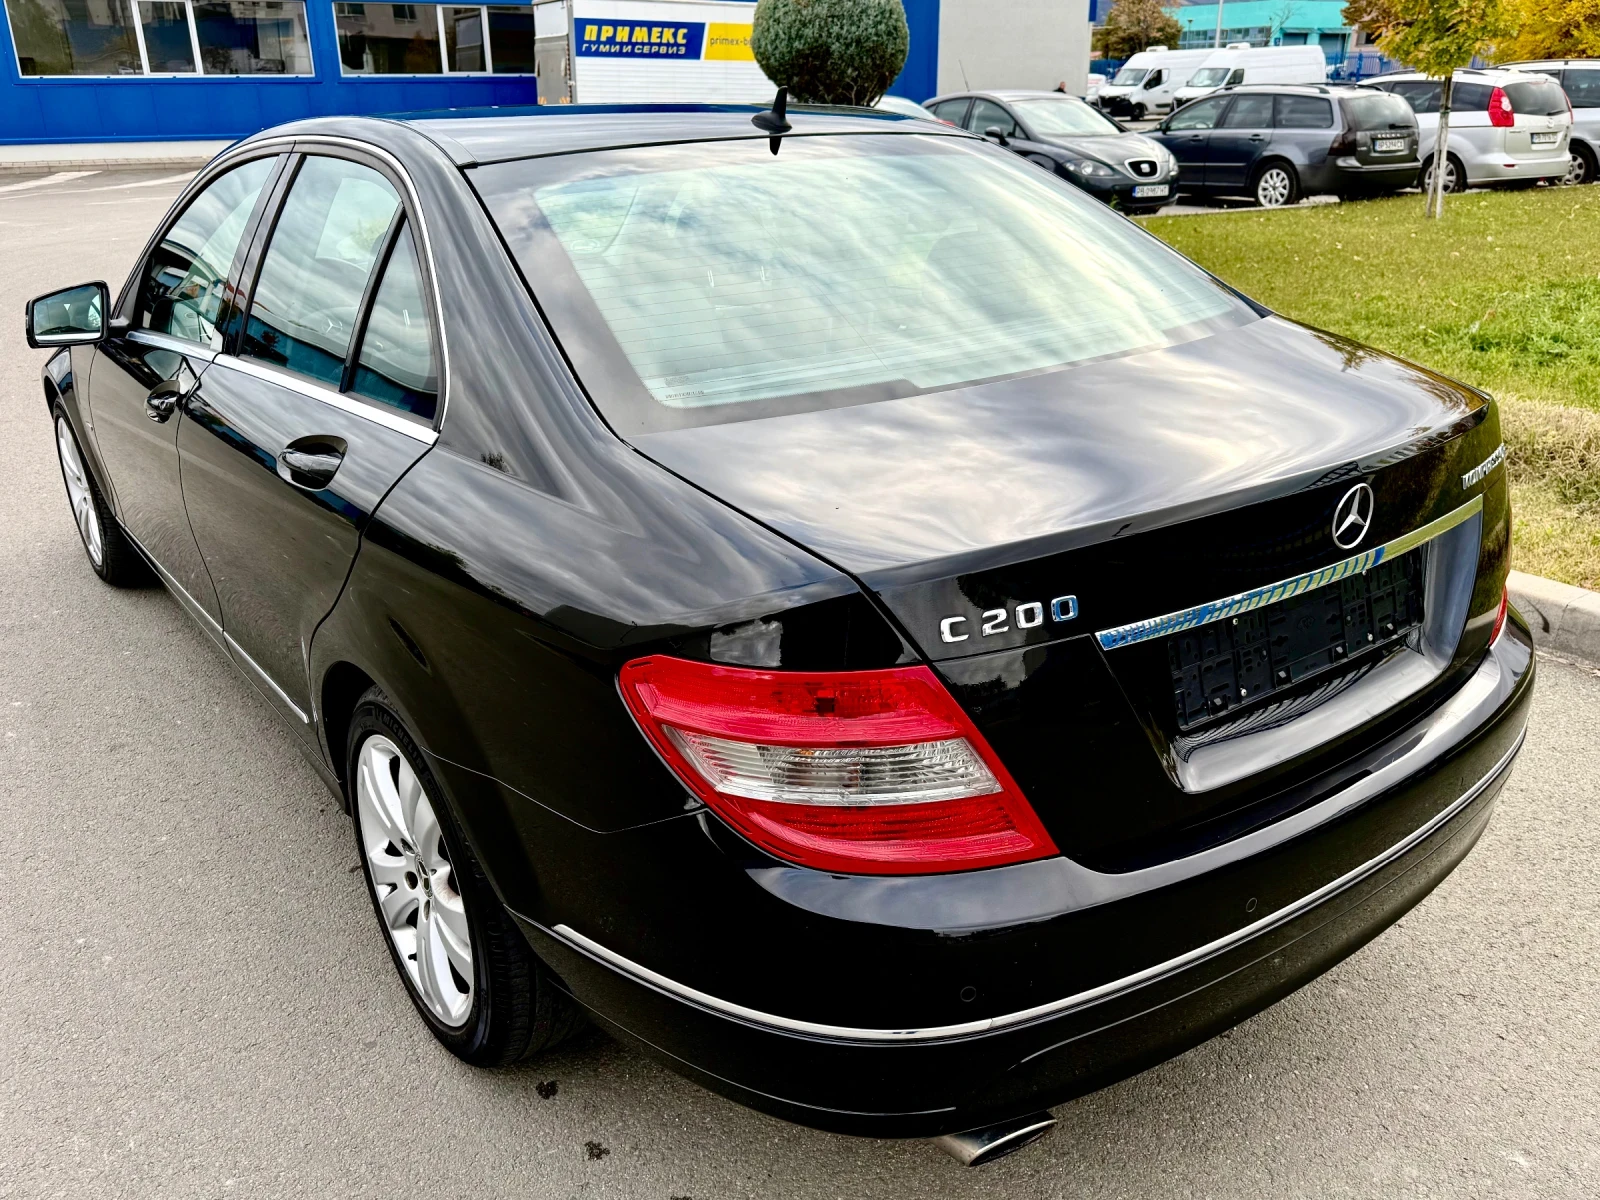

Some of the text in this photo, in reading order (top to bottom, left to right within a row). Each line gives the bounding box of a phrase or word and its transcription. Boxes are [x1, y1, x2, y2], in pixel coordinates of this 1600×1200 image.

[582, 43, 686, 55] ГУМИ И СЕРВИЗ
[584, 25, 688, 44] ПРИМЕКС
[940, 595, 1079, 643] C 200
[382, 712, 425, 769] MICHELIN
